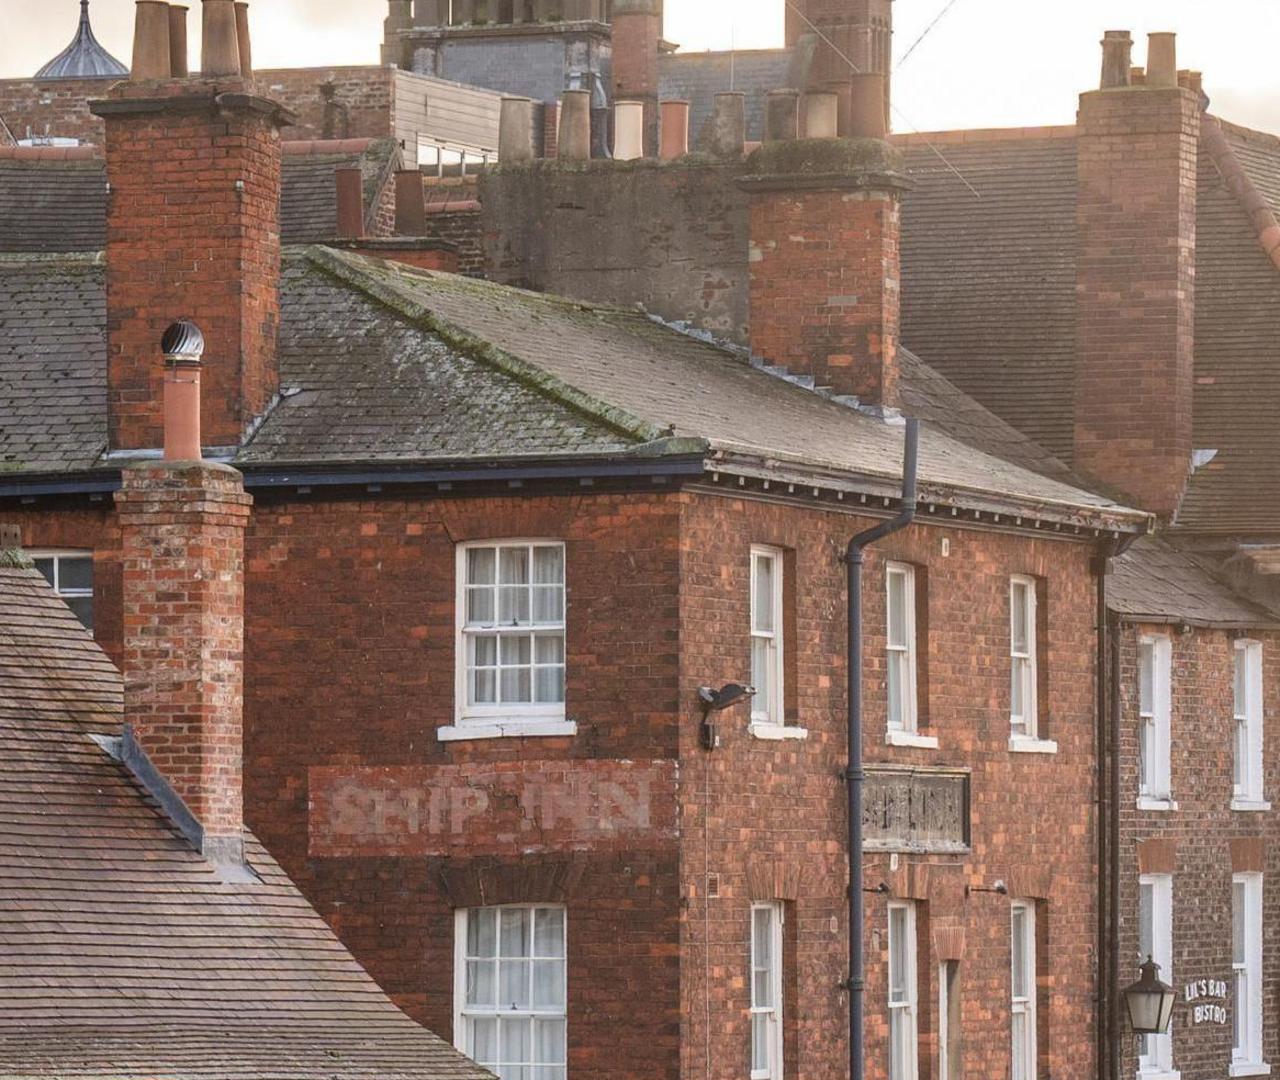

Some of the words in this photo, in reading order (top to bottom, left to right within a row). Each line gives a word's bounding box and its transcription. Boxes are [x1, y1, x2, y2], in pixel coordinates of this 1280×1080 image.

[330, 783, 489, 834] SHIP
[1209, 979, 1226, 998] BAR
[1194, 1005, 1226, 1024] BISTRO
